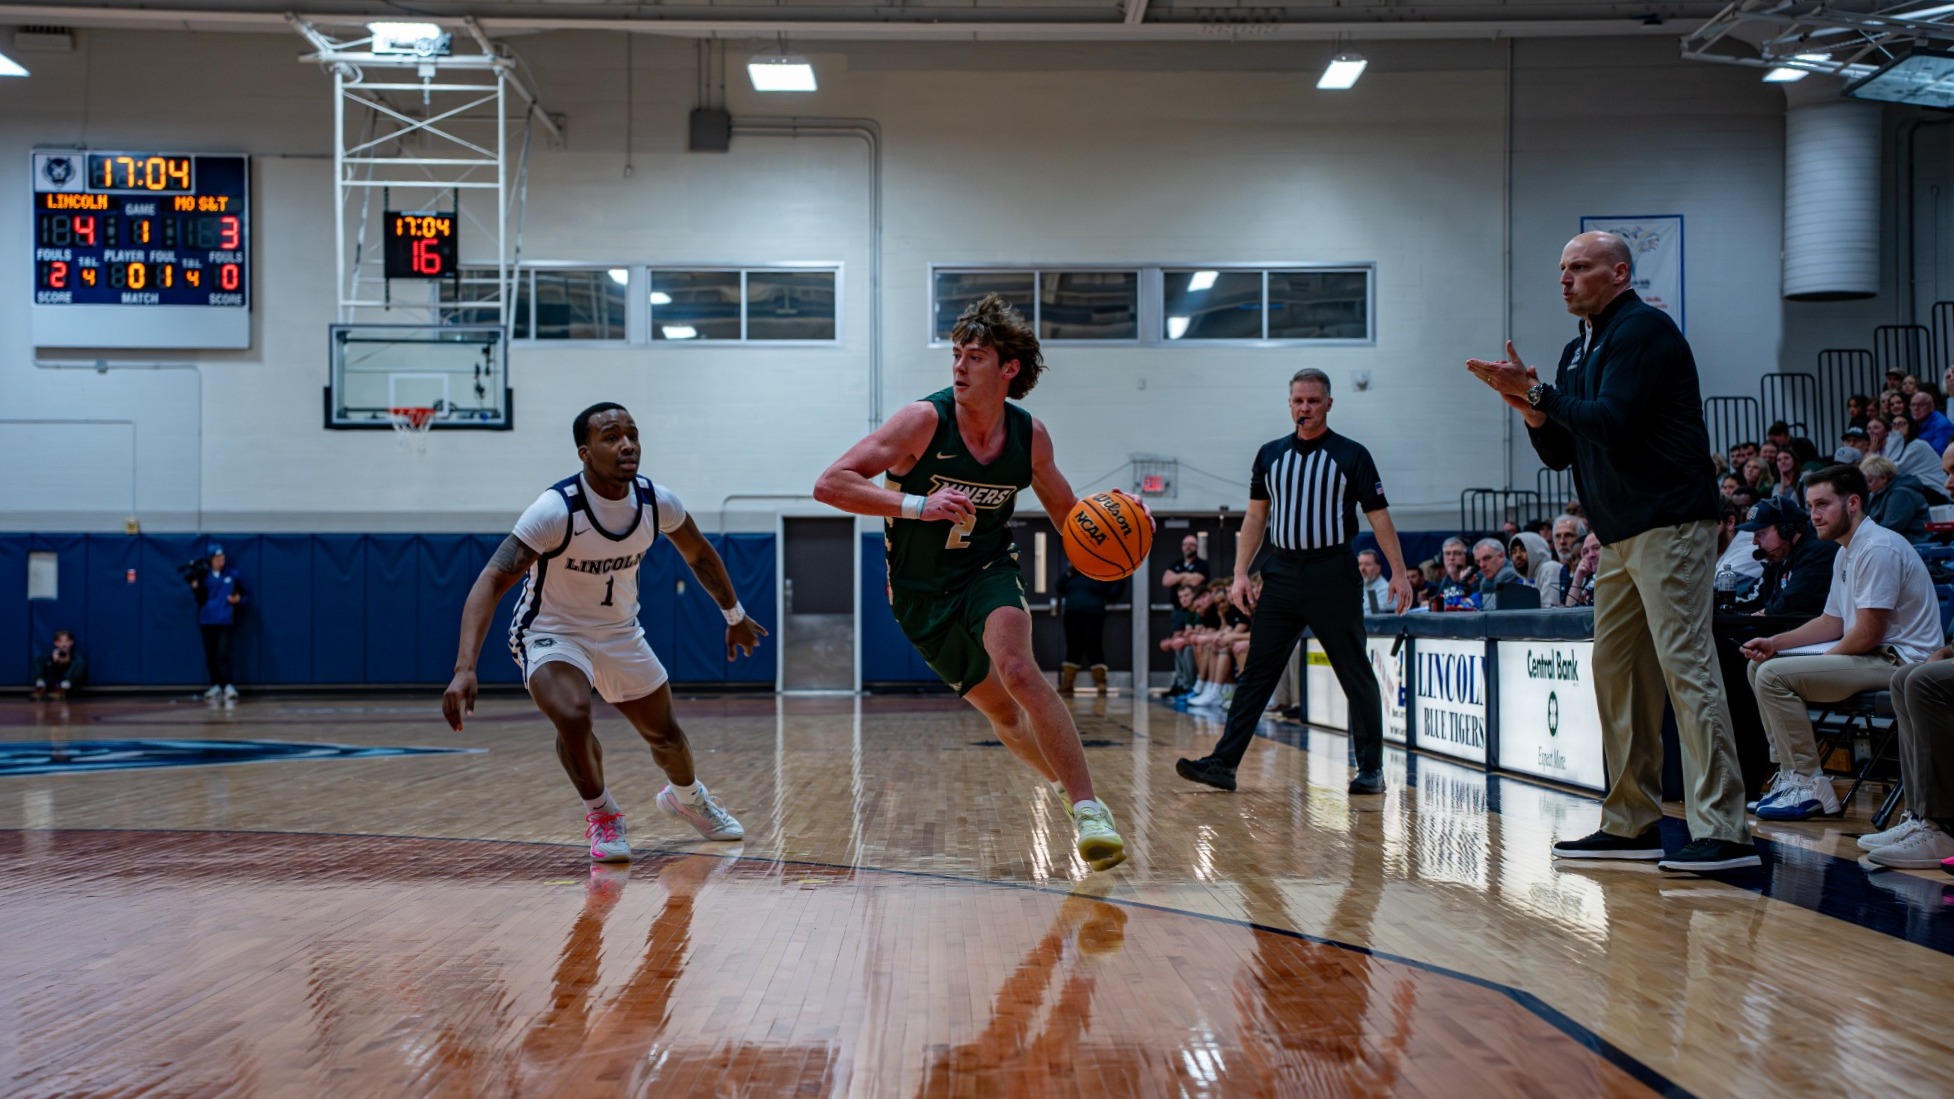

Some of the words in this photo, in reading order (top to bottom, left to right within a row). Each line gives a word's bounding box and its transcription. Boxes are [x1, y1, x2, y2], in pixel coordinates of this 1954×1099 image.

[103, 156, 190, 191] 17:04
[47, 193, 108, 210] LINCOLN
[125, 203, 156, 216] GAME
[174, 196, 196, 211] MO
[198, 196, 229, 212] S&T
[73, 215, 96, 246] 4
[141, 219, 150, 243] 1
[220, 216, 239, 250] 3
[396, 216, 450, 238] 17:04
[36, 248, 72, 261] FOULS
[104, 249, 145, 262] PLAYER
[149, 250, 176, 263] FOUL
[208, 250, 243, 263] FOULS
[412, 238, 442, 274] 16
[49, 261, 68, 288] 2
[82, 269, 96, 286] 4
[127, 262, 146, 289] 0
[165, 264, 173, 288] 1
[186, 270, 200, 287] 4
[221, 264, 239, 289] 0
[37, 290, 72, 304] SCORE
[121, 292, 160, 304] MATCH
[208, 292, 243, 305] SCORE
[1092, 492, 1132, 537] Wilson
[945, 512, 977, 549] 2
[1074, 510, 1107, 546] NCAA
[600, 575, 614, 606] 1
[1527, 648, 1555, 680] Central
[1556, 649, 1579, 682] Bank
[1423, 706, 1447, 740] BLUE
[1448, 710, 1485, 750] TIGERS
